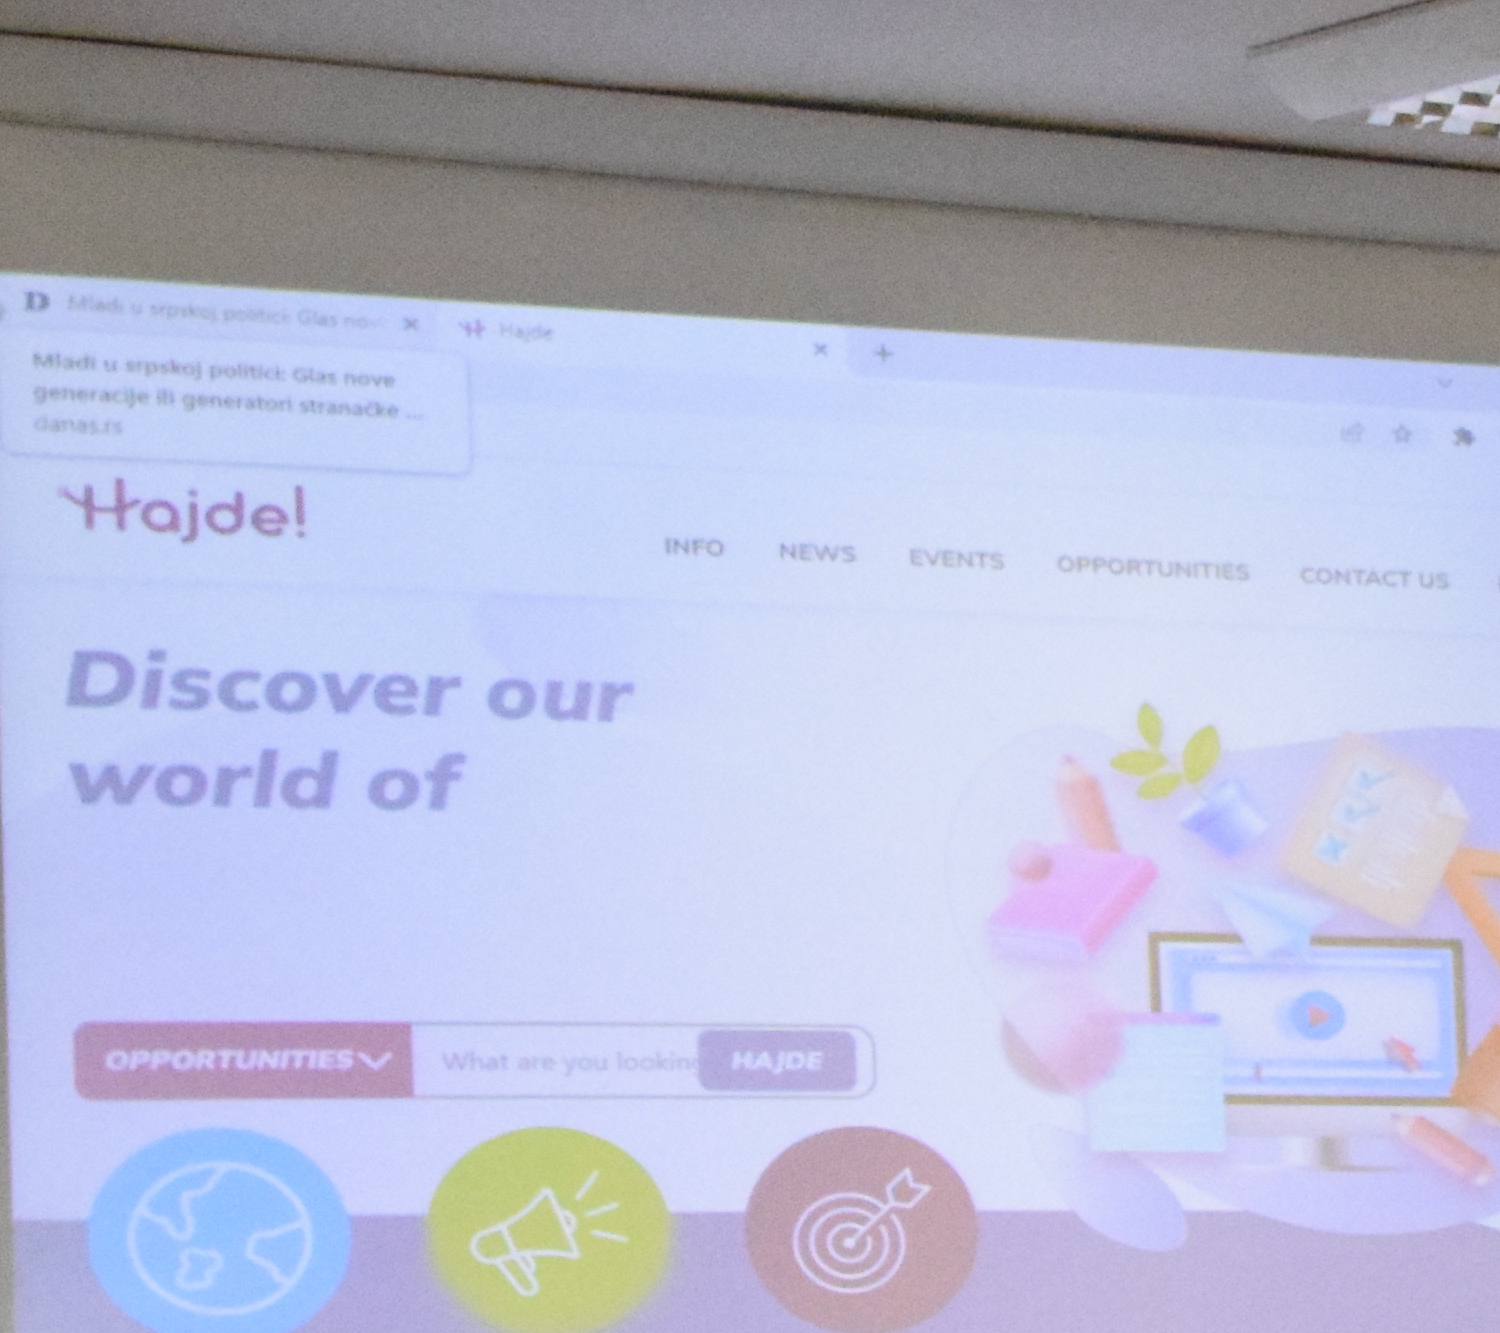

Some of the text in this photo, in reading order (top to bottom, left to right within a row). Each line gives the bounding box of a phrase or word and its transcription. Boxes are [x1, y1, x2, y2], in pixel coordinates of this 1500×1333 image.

[499, 320, 555, 343] Hajde
[32, 351, 97, 371] Mladi
[103, 359, 118, 373] u
[125, 359, 202, 382] srpskoj
[292, 367, 336, 386] Glas
[343, 372, 397, 388] nove
[33, 384, 150, 409] generacije
[156, 386, 175, 406] ili
[181, 391, 292, 414] generatori
[33, 415, 123, 436] danas.rs
[58, 478, 307, 544] Hajde!
[664, 537, 725, 558] INFO
[778, 542, 857, 564] NEWS
[908, 548, 1006, 571] EVENTS
[1056, 555, 1251, 582] OPPORTUNITIES
[1299, 566, 1412, 589] CONTACT
[1418, 572, 1450, 590] US
[65, 649, 635, 723] Discover our
[68, 748, 467, 812] world of
[105, 1049, 354, 1071] OPPORTUNITIES
[442, 1051, 508, 1071] What
[517, 1055, 557, 1072] are
[562, 1055, 609, 1078] you
[731, 1050, 824, 1075] HAJDE
